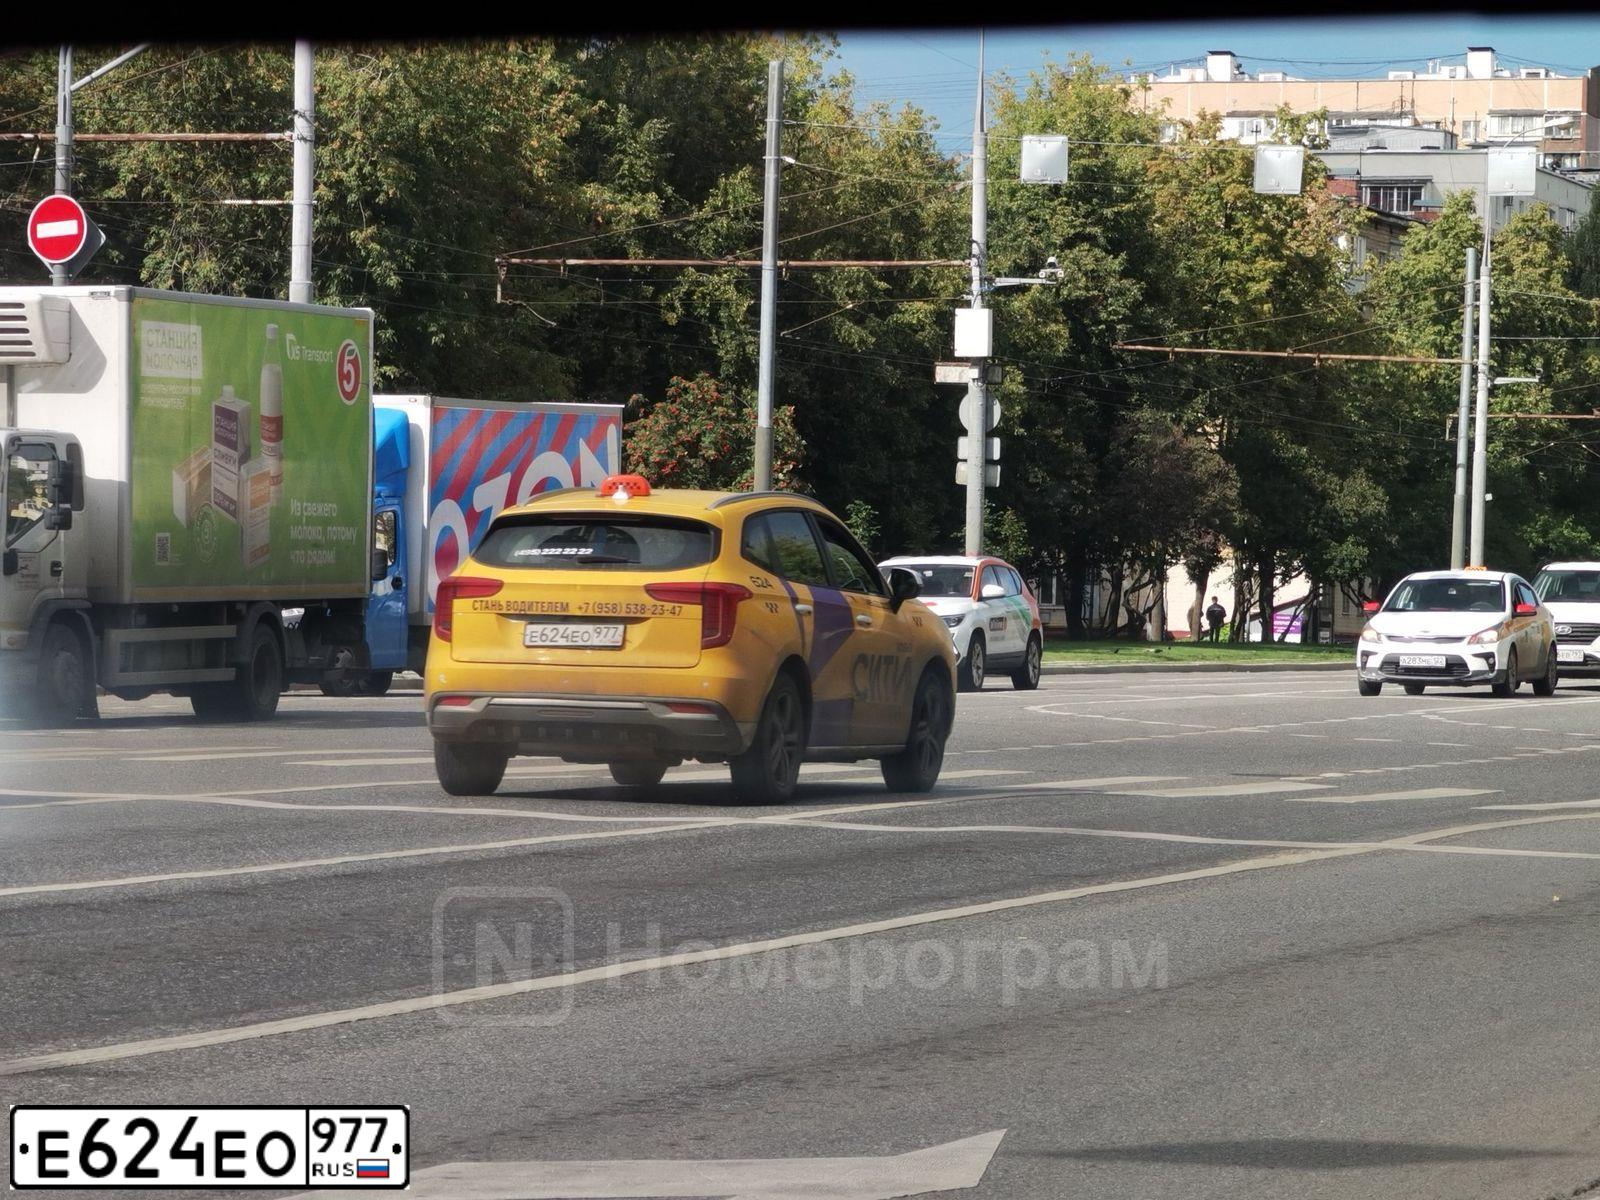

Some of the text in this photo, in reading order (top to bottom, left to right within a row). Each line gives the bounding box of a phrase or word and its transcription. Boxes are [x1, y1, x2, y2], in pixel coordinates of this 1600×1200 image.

[146, 328, 198, 350] СТАНЦИЯ
[302, 346, 334, 362] Transport
[471, 600, 683, 617] СТАНЬ ВОДИТЕЛЕМ +7 (958) 538-23-47
